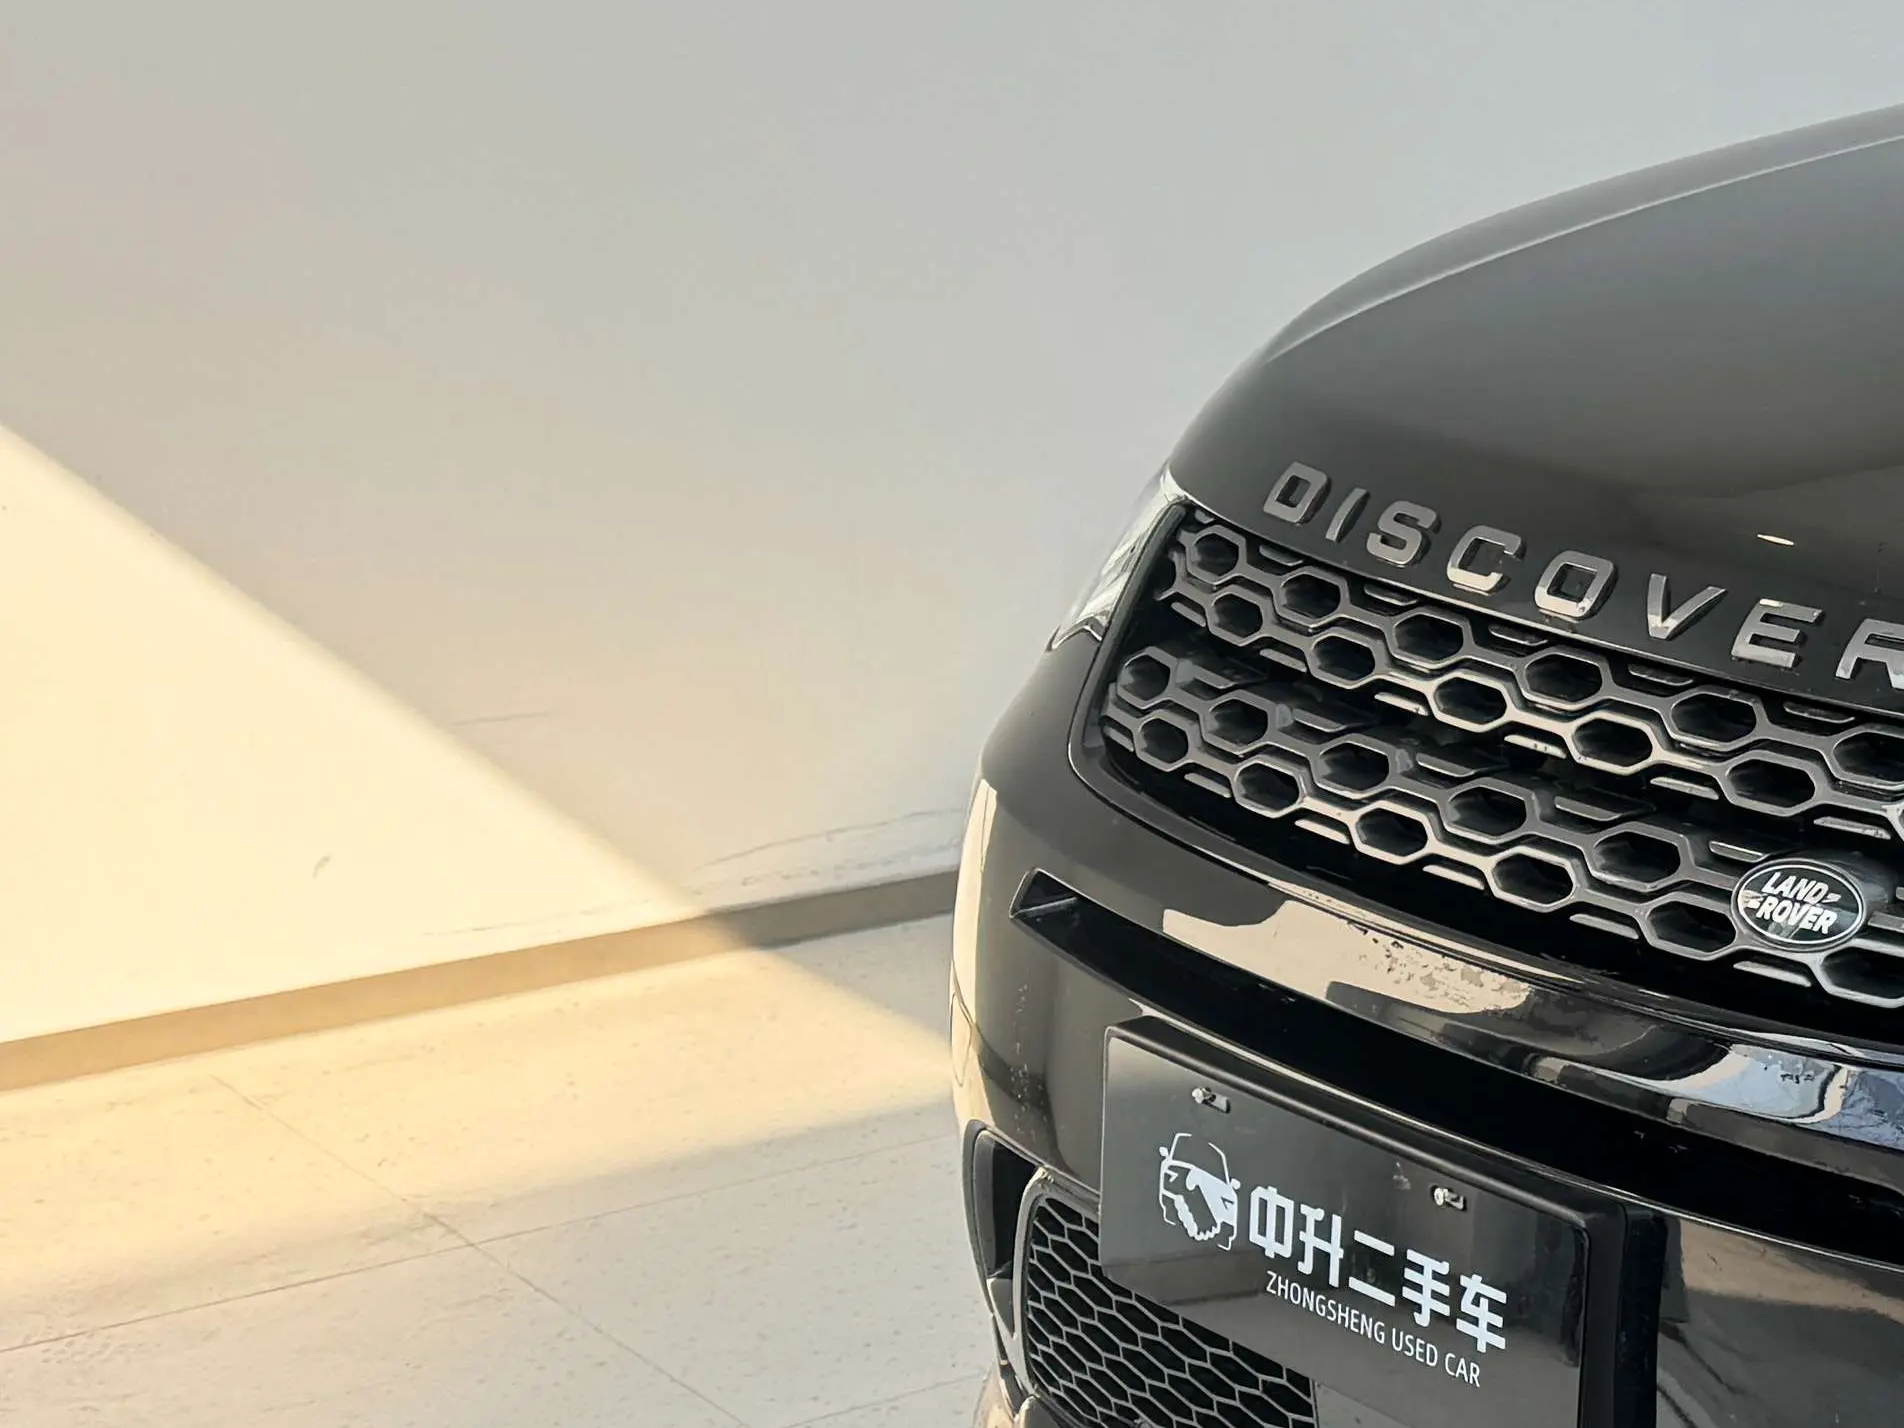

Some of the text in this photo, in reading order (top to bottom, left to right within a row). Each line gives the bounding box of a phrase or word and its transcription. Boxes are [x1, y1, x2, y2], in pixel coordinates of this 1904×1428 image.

[1755, 896, 1838, 935] ROVER
[1761, 871, 1829, 905] LAND
[1248, 1184, 1508, 1354] 中升二手车
[1265, 1270, 1482, 1389] ZHONGSHENG USED CAR
